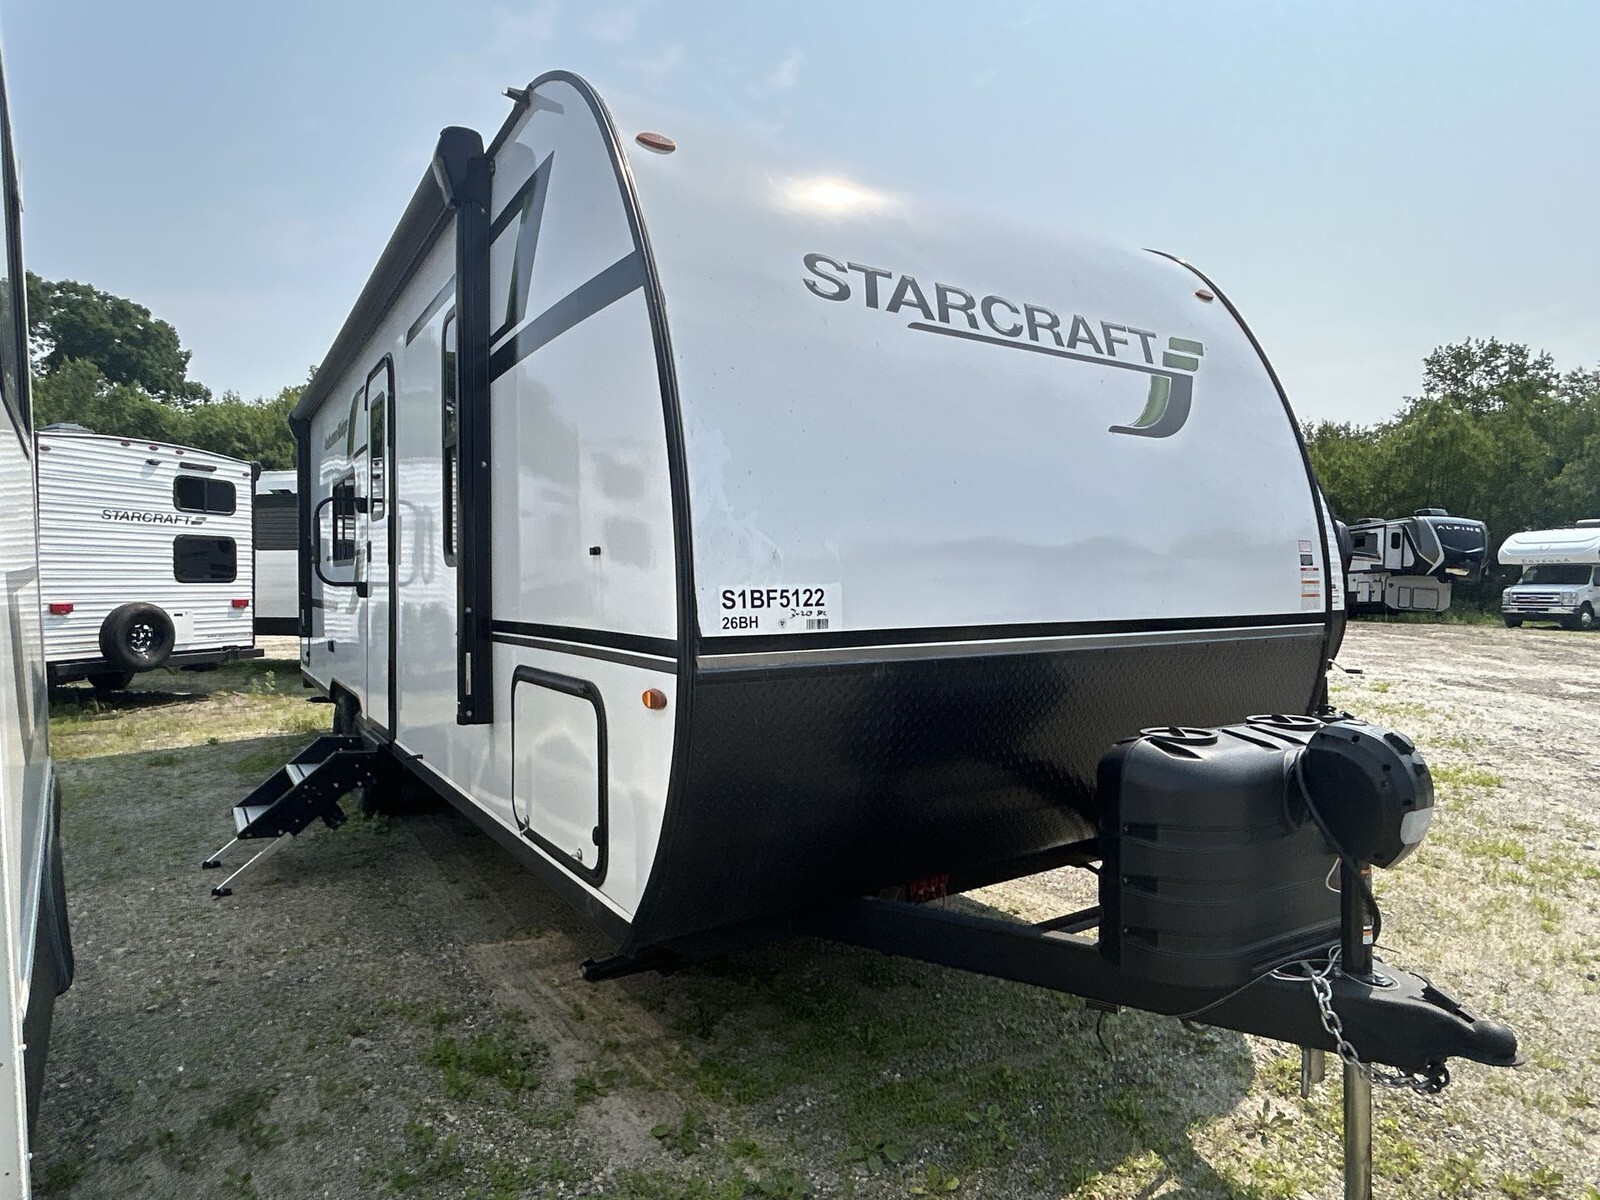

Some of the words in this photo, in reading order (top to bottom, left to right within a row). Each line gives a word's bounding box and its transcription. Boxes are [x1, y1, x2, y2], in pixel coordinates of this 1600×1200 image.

[803, 253, 1157, 364] STARCRAFT
[101, 509, 192, 525] STARCRAFT
[1437, 525, 1481, 533] ALPINE
[722, 588, 825, 609] S1BF5122
[722, 616, 758, 629] 26BH
